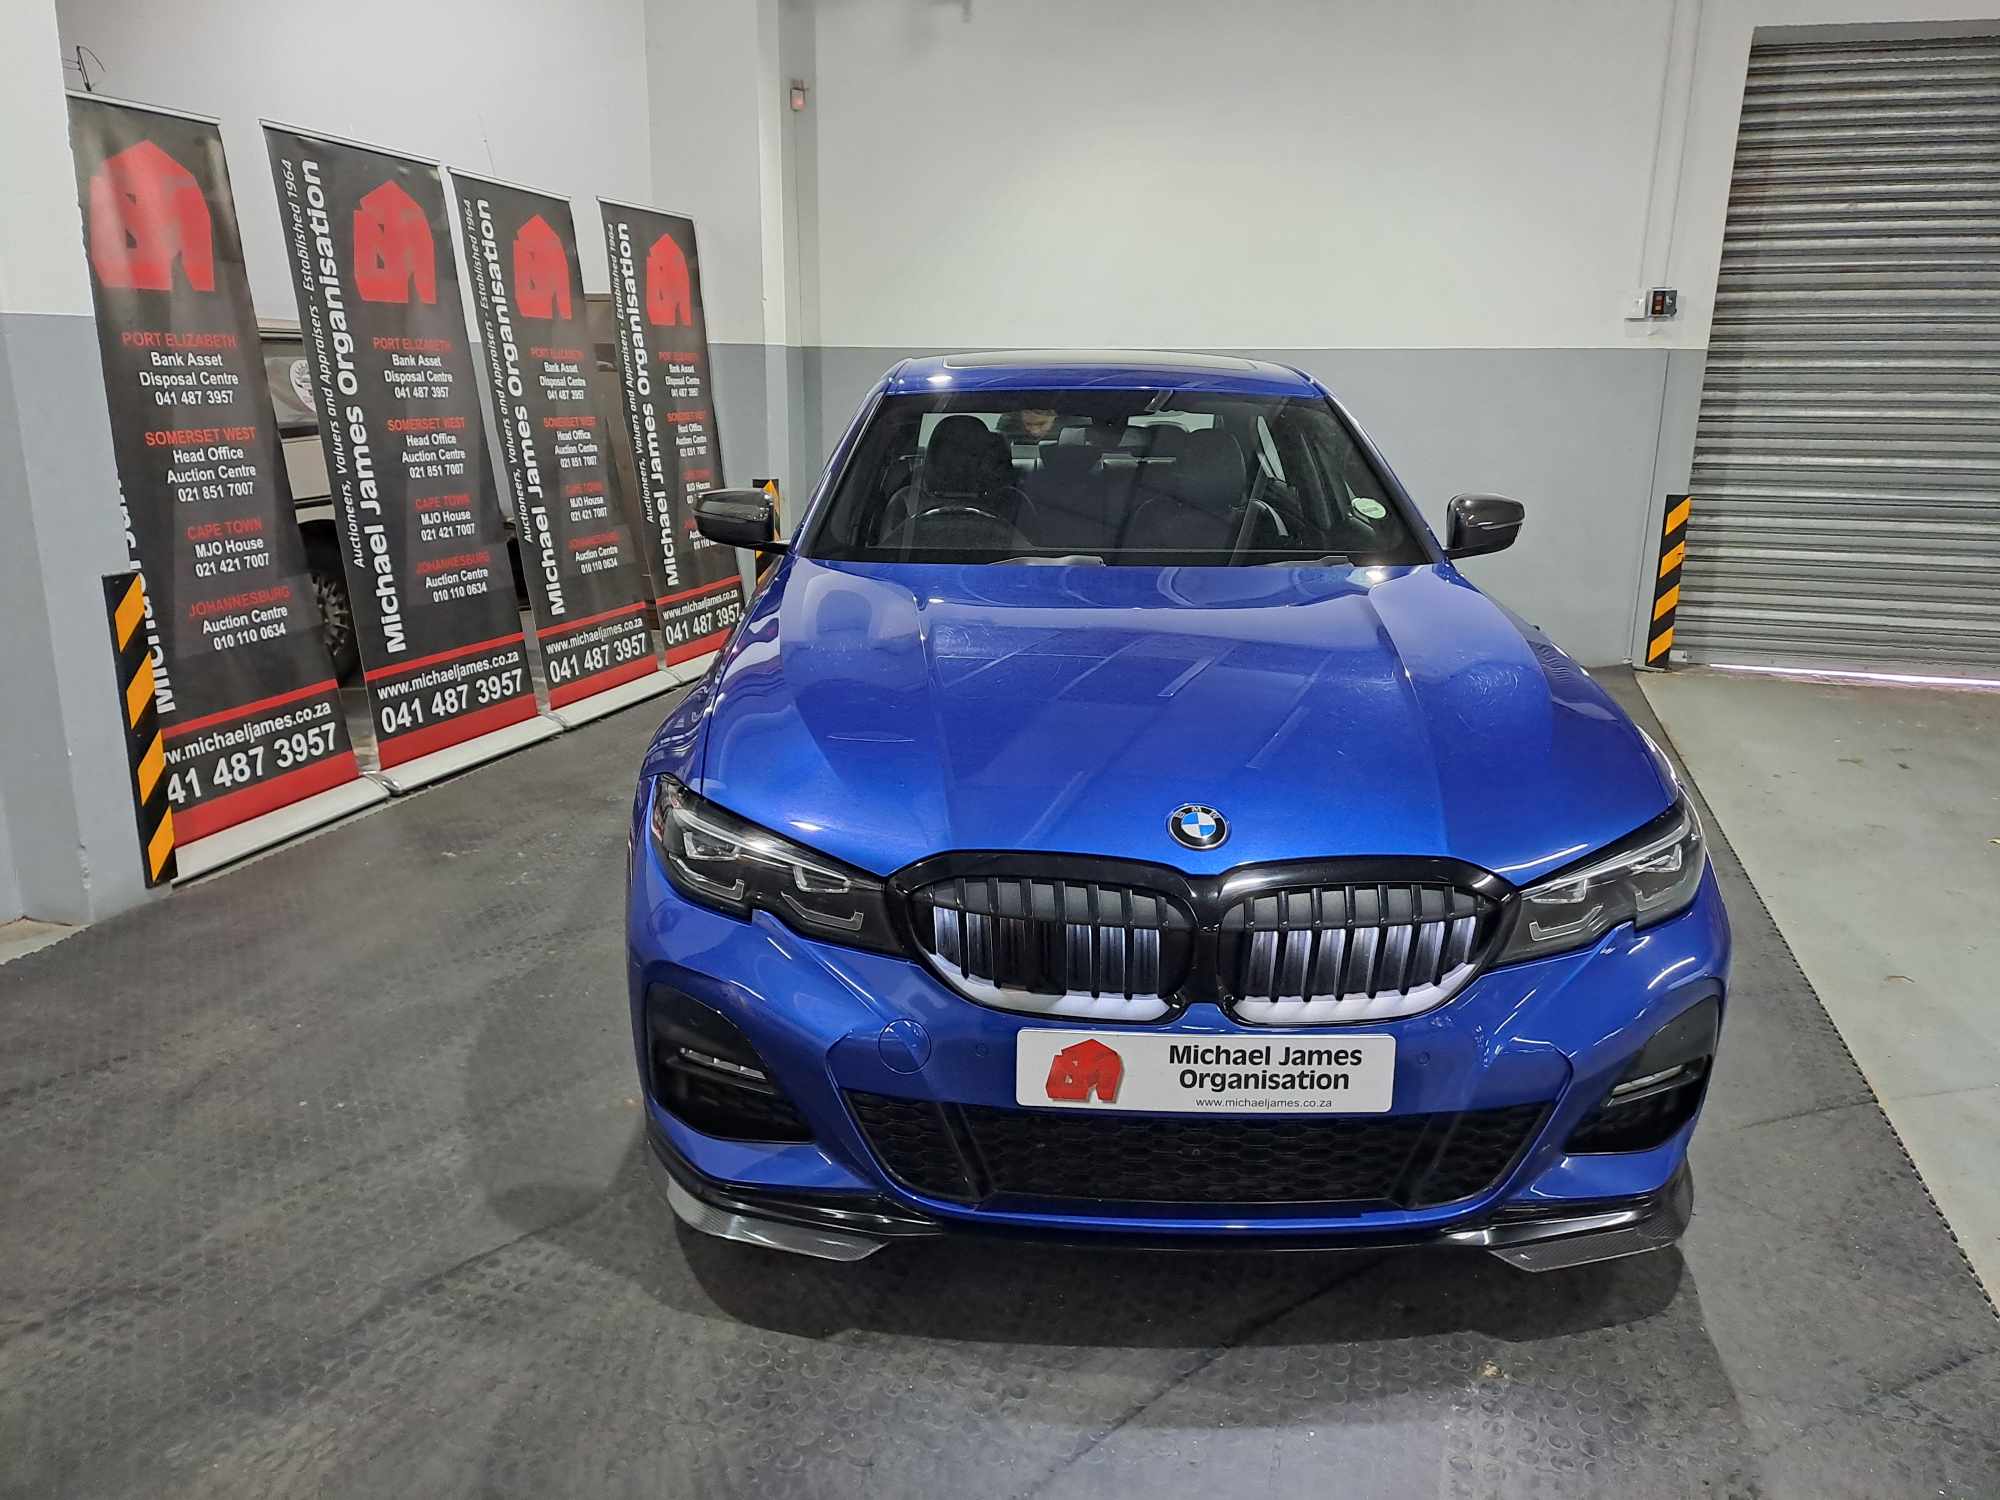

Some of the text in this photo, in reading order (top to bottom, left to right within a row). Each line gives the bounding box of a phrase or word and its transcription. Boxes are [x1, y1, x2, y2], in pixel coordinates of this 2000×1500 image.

[281, 158, 298, 198] 1964
[288, 201, 315, 292] Established
[121, 332, 161, 347] PORT
[309, 304, 332, 385] Appraisers
[151, 352, 223, 366] Bank Asset
[392, 354, 441, 366] Bank Asset
[139, 372, 239, 388] Disposal Centre
[384, 370, 453, 384] Disposal Centre
[156, 390, 233, 405] 041 487 3957
[320, 387, 337, 417] and
[394, 387, 411, 398] 041
[413, 387, 428, 398] 487
[496, 389, 508, 415] and
[302, 160, 407, 653] Michael James Organisation
[477, 199, 566, 616] Michael James Organisation
[617, 223, 680, 586] Michael James Organisation
[144, 427, 256, 446] SOMERSET WEST
[330, 420, 348, 474] Valuers
[406, 433, 457, 446] Head Office
[503, 418, 517, 464] Valuers
[173, 446, 244, 464] Head Office
[402, 449, 466, 463] Auction Centre
[167, 464, 256, 484] Auction Centre
[409, 463, 464, 478] 021 851 7007
[178, 482, 253, 502] 021 851 7007
[513, 469, 533, 543] Auctioneers,
[187, 517, 262, 540] CAPE TOWN
[341, 480, 366, 569] Auctioneers,
[421, 511, 470, 525] MJO House
[421, 523, 475, 541] 021 421 7007
[195, 538, 264, 559] MJO House
[195, 552, 270, 578] 021 421 7007
[425, 568, 488, 589] Auction Centre
[432, 581, 487, 603] 010 110 0634
[202, 605, 288, 635] Auction Centre
[665, 602, 740, 645] 041 487 3957
[213, 622, 286, 651] 010 110 0634
[546, 618, 643, 655] www.michaeljames.co.za
[549, 633, 646, 683] 041 487 3957
[377, 651, 519, 700] www.michaeljames.co.za
[381, 668, 523, 734] 041 487 3957
[213, 746, 265, 788] 487
[274, 722, 336, 768] 3957
[1169, 1044, 1363, 1066] Michael James
[1179, 1070, 1350, 1092] Organisation
[1196, 1097, 1333, 1111] www.michaeljames.co.za
